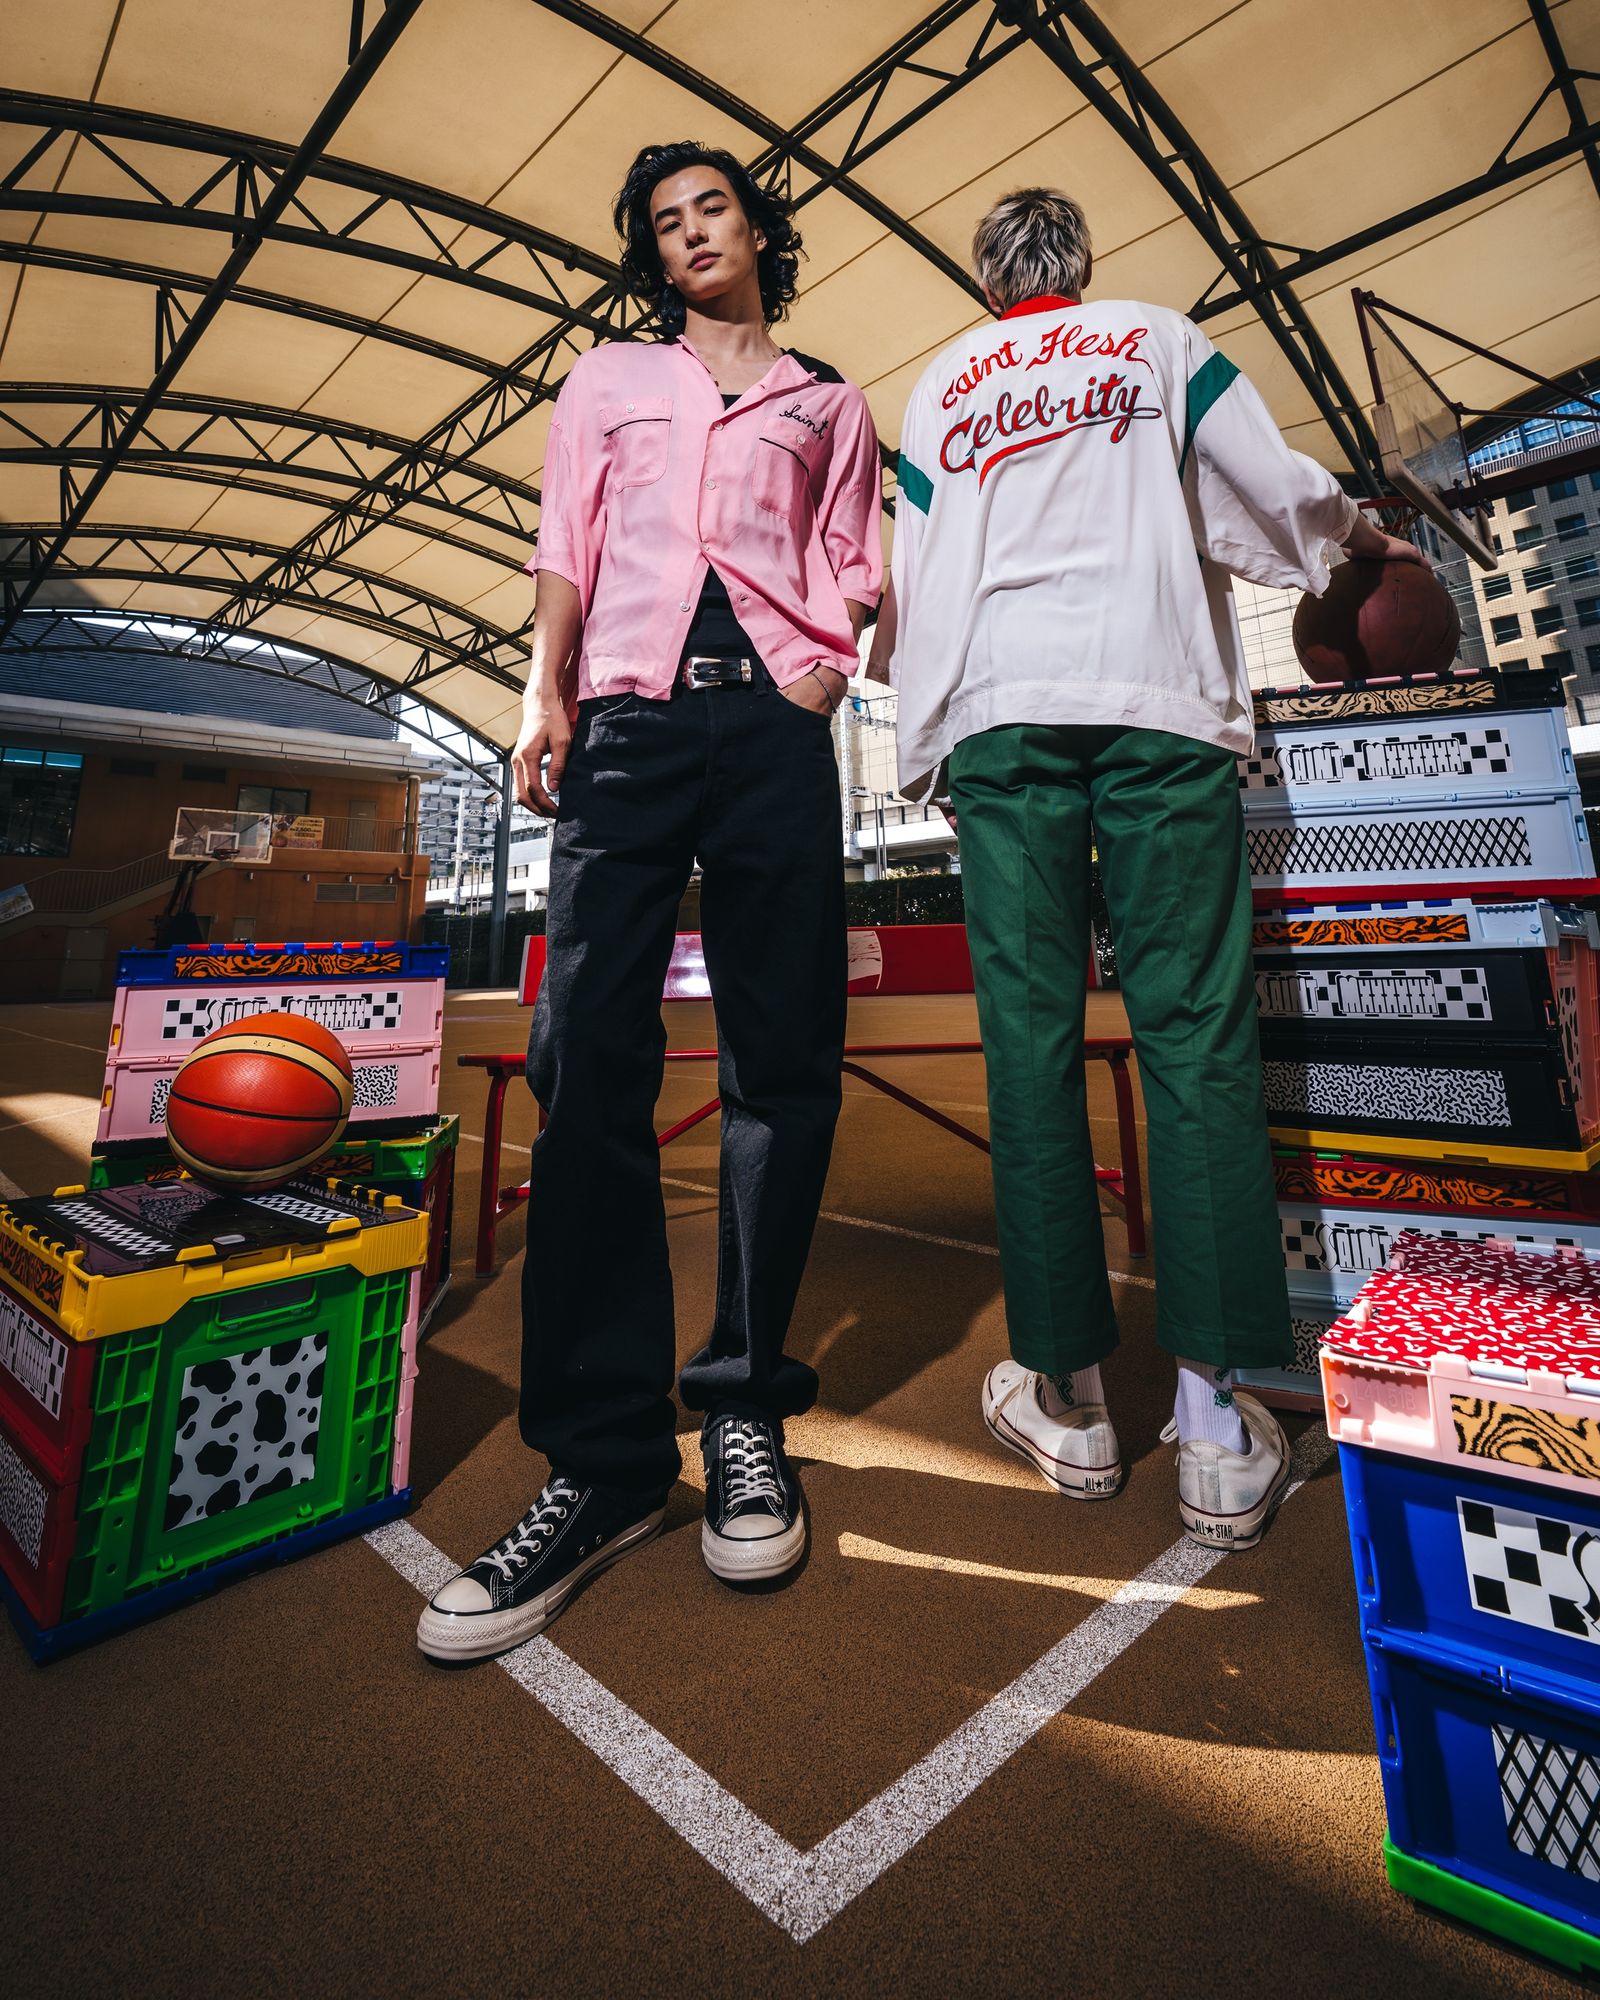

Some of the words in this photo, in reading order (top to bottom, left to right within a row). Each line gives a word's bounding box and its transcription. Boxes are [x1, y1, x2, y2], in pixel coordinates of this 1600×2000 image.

[779, 404, 829, 440] Saint
[939, 373, 1163, 482] Celebrity
[1275, 745, 1344, 785] SAINT
[1256, 974, 1319, 1016] SAINT
[1215, 1524, 1233, 1539] STAR
